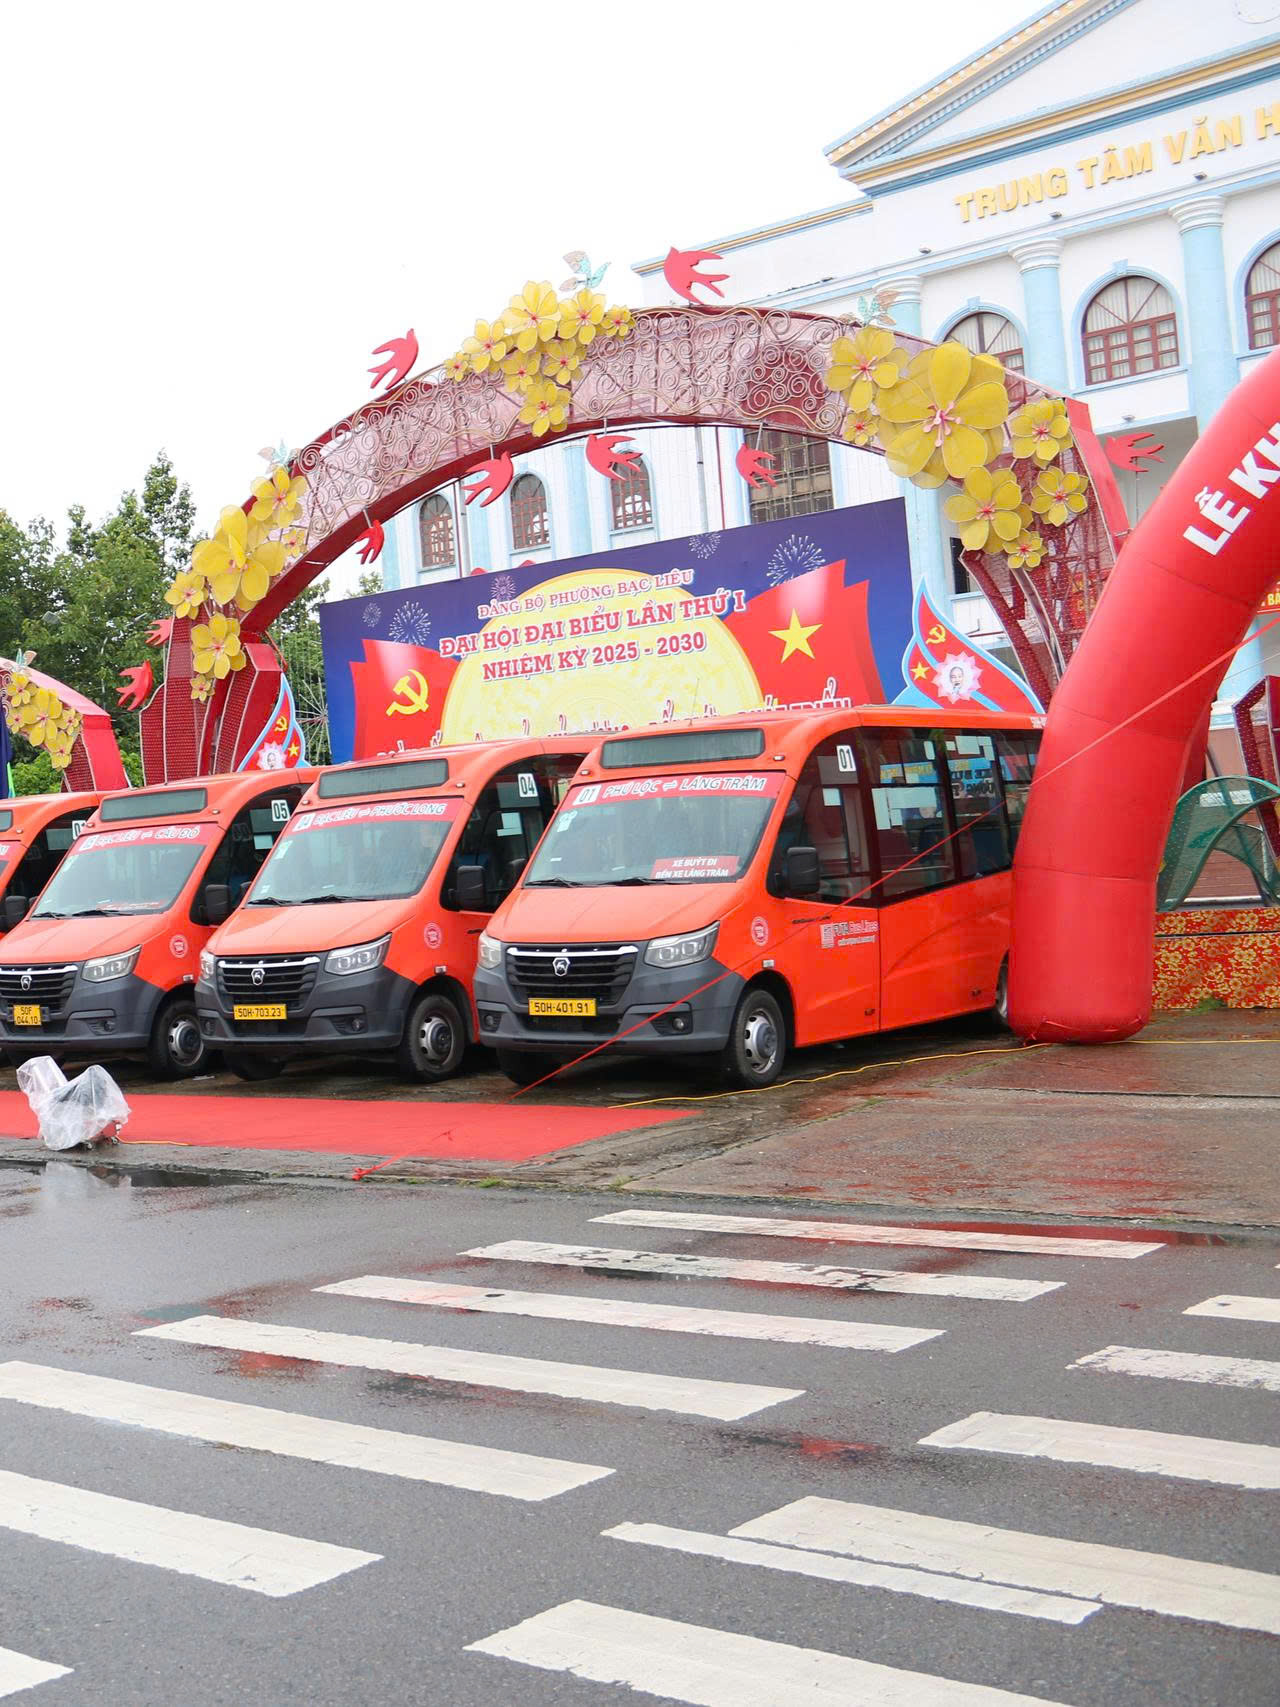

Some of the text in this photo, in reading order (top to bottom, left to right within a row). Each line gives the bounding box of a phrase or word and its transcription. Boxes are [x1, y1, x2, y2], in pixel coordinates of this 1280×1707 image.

[954, 167, 1069, 223] TRUNG
[1077, 144, 1154, 188] TÂM
[1163, 114, 1243, 165] VĂN
[1183, 486, 1251, 556] LỄ
[478, 568, 695, 619] ĐẢNG BỘ PHƯỜNG BẠC LIÊU
[440, 588, 746, 658] ĐẠI HỘI ĐẠI BIỂU LẦN THỨ I
[482, 652, 554, 682] NHIỆM
[557, 644, 587, 671] KỲ
[591, 641, 638, 666] 2025
[656, 630, 707, 657] 2030
[839, 746, 854, 769] 01
[519, 776, 537, 796] 04
[578, 787, 596, 802] 01
[602, 780, 631, 799] PHÚ
[631, 778, 663, 797] LỘC
[679, 776, 721, 792] LÁNG
[273, 802, 288, 820] 05
[410, 802, 448, 815] LONG
[237, 1005, 283, 1019] 50H-703.23
[534, 1000, 592, 1016] 50H-401.91
